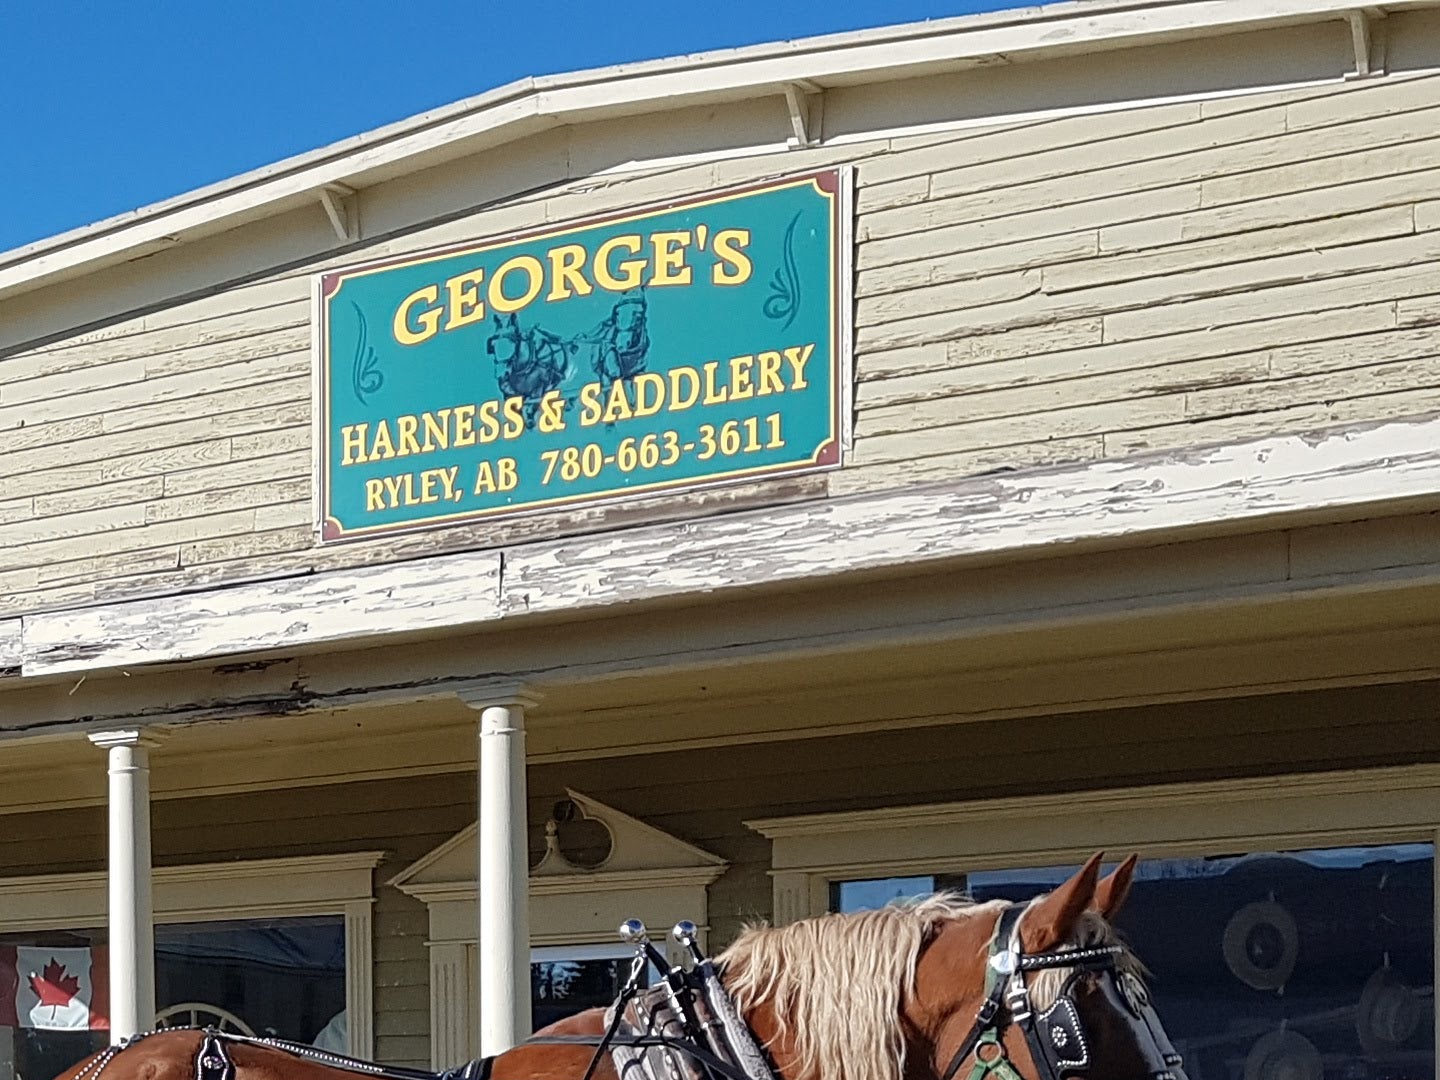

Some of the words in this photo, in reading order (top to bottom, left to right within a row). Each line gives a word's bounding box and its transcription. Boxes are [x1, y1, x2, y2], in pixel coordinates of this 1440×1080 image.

[392, 224, 753, 346] GEORGE'S
[340, 396, 525, 466] HARNESS
[538, 390, 566, 433] &
[580, 343, 816, 427] SADDLERY
[365, 466, 464, 512] RYLEY,
[474, 457, 518, 495] AB
[540, 412, 786, 485] 780-663-3611
